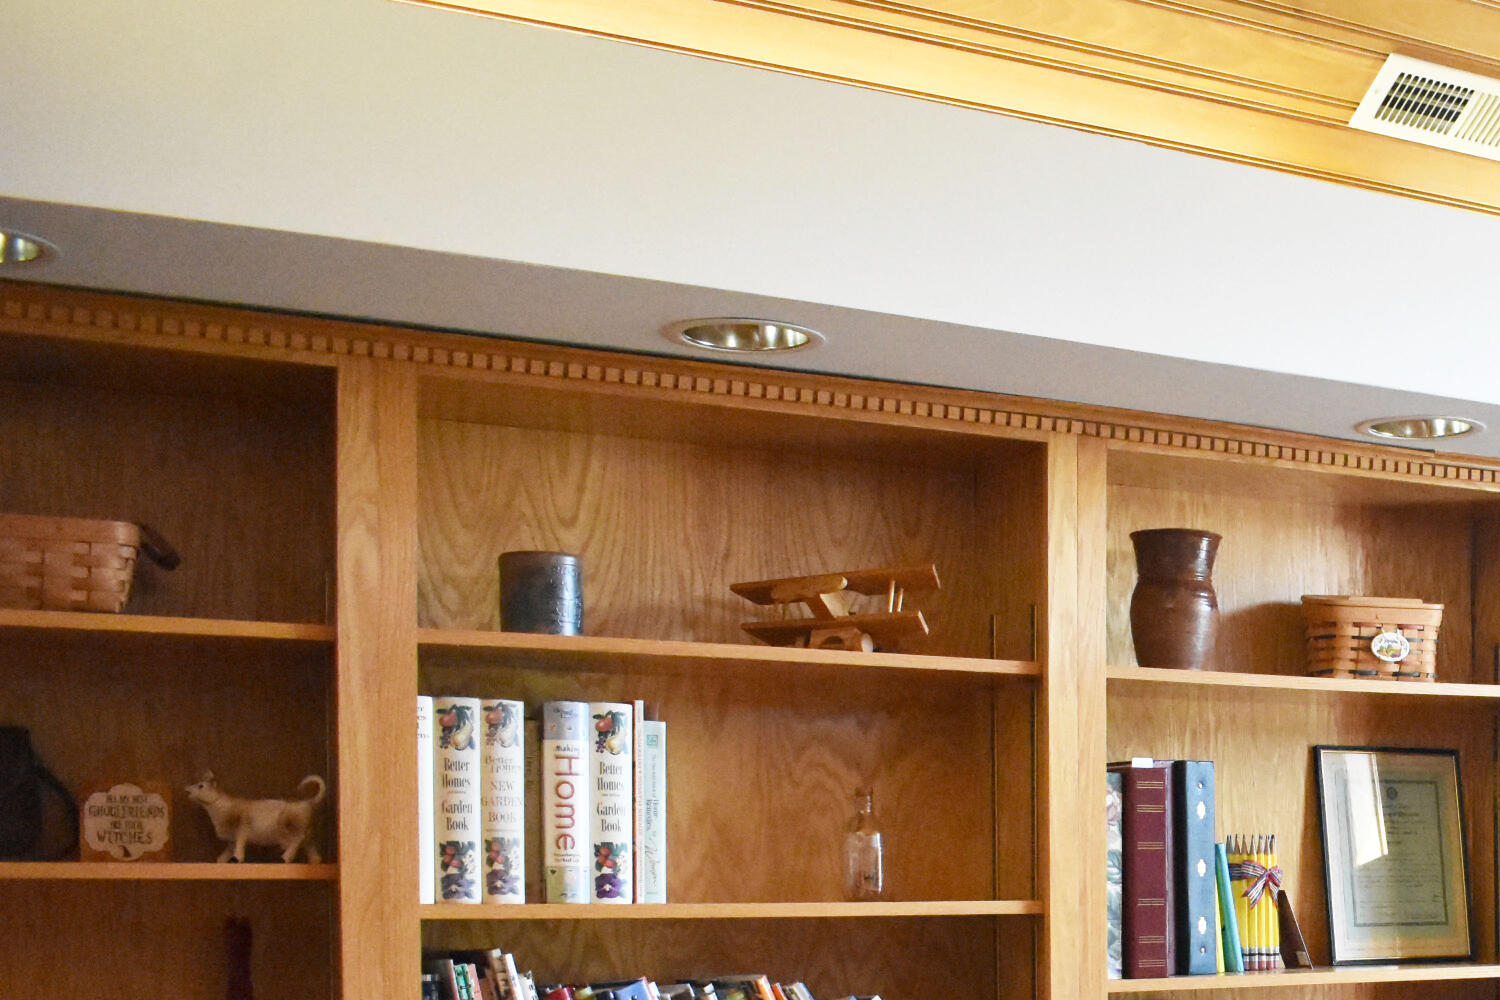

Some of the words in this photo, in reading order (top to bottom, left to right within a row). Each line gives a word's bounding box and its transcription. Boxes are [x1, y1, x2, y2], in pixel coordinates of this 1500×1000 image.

[444, 758, 470, 772] Better
[599, 761, 622, 775] Better
[490, 780, 513, 791] NEW
[441, 800, 473, 815] Garden
[554, 756, 583, 851] Home
[446, 817, 469, 831] Book
[601, 818, 622, 833] Book
[97, 830, 154, 844] WITCHES
